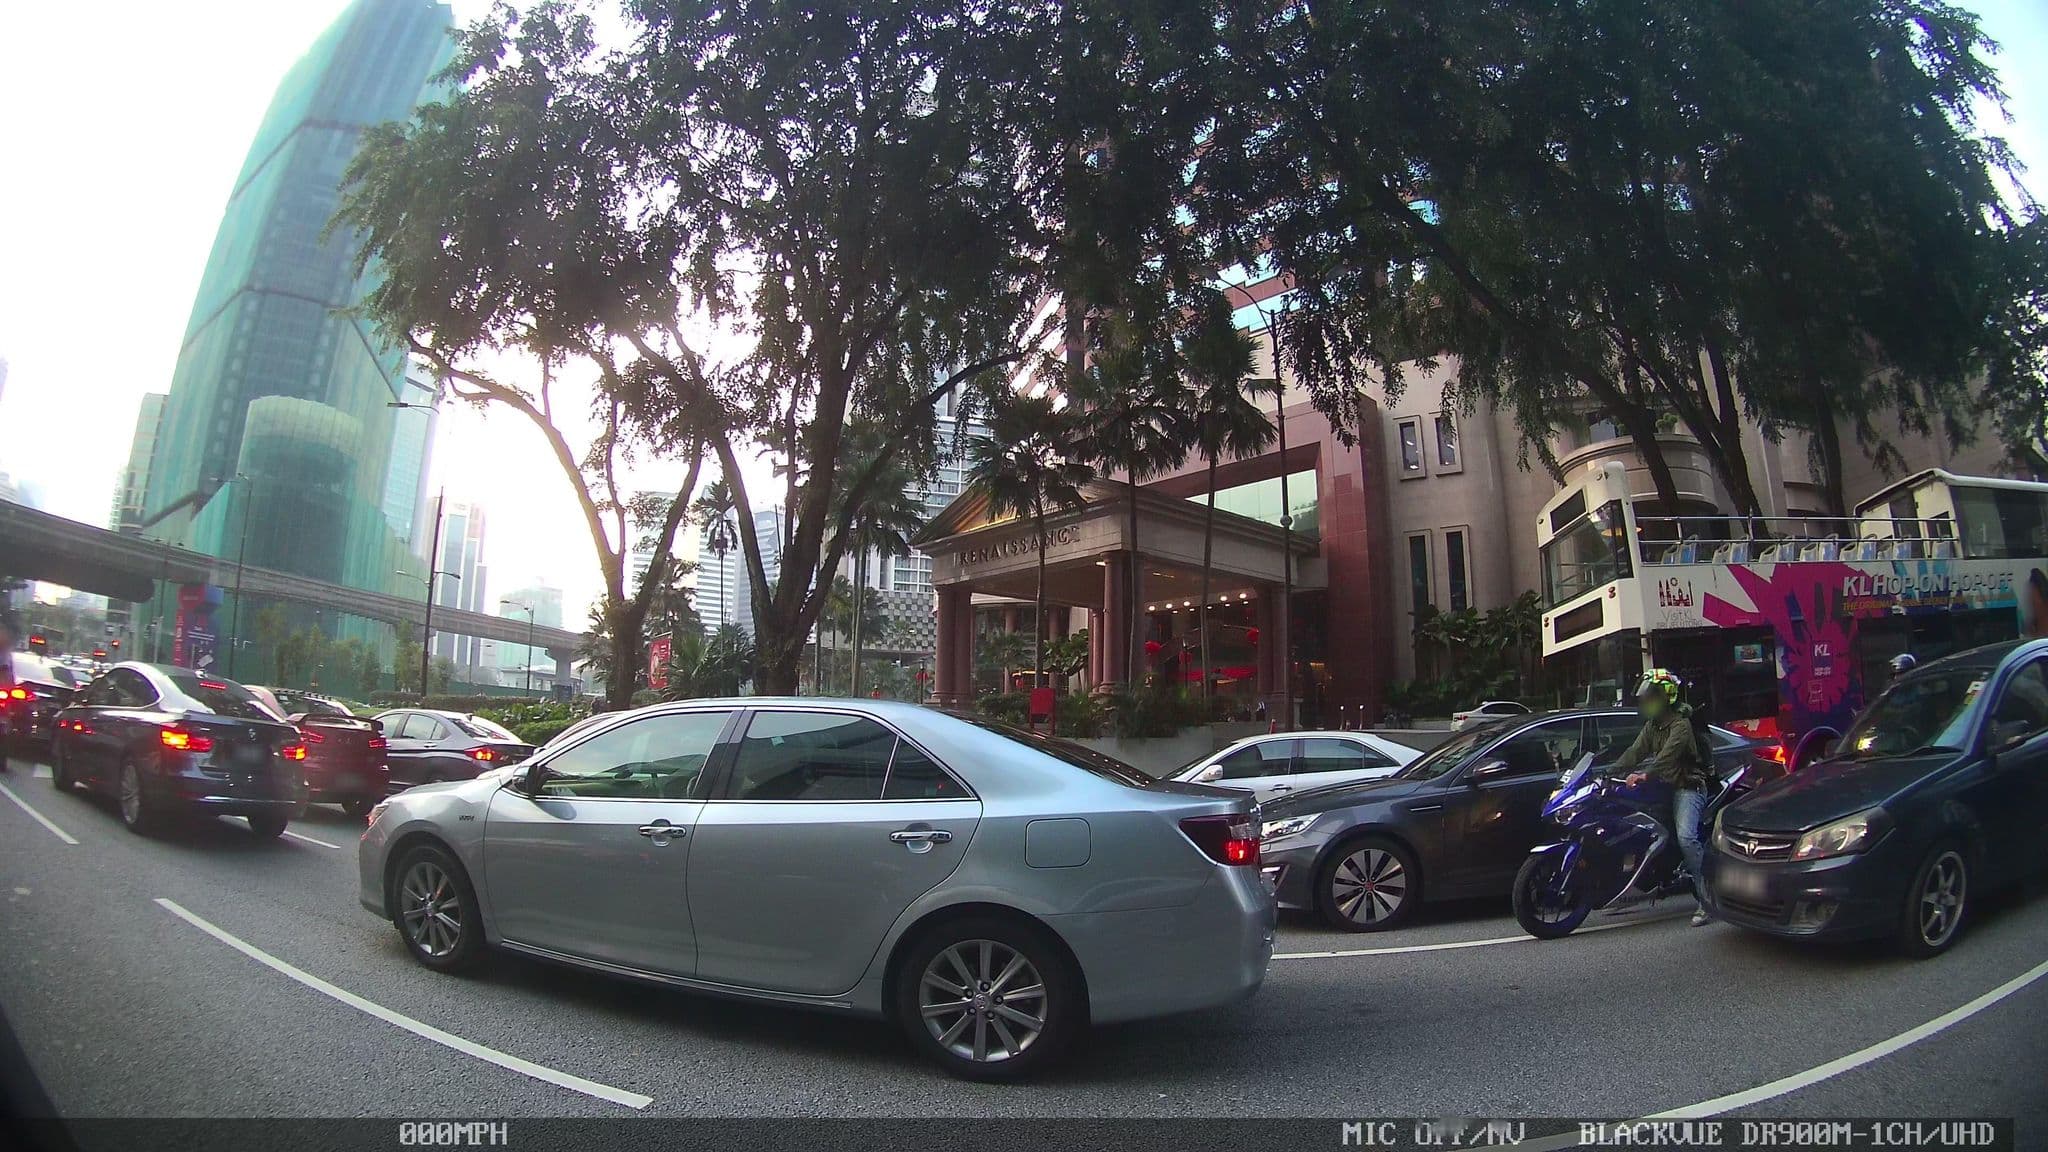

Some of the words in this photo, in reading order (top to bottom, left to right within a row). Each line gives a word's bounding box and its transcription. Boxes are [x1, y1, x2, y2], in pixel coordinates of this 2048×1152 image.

[959, 525, 1081, 566] RENAISSANCE
[1842, 576, 1871, 597] KL
[1872, 574, 1945, 596] HOP-ON
[1949, 572, 2014, 592] HOP-OFF
[1814, 643, 1831, 657] KL
